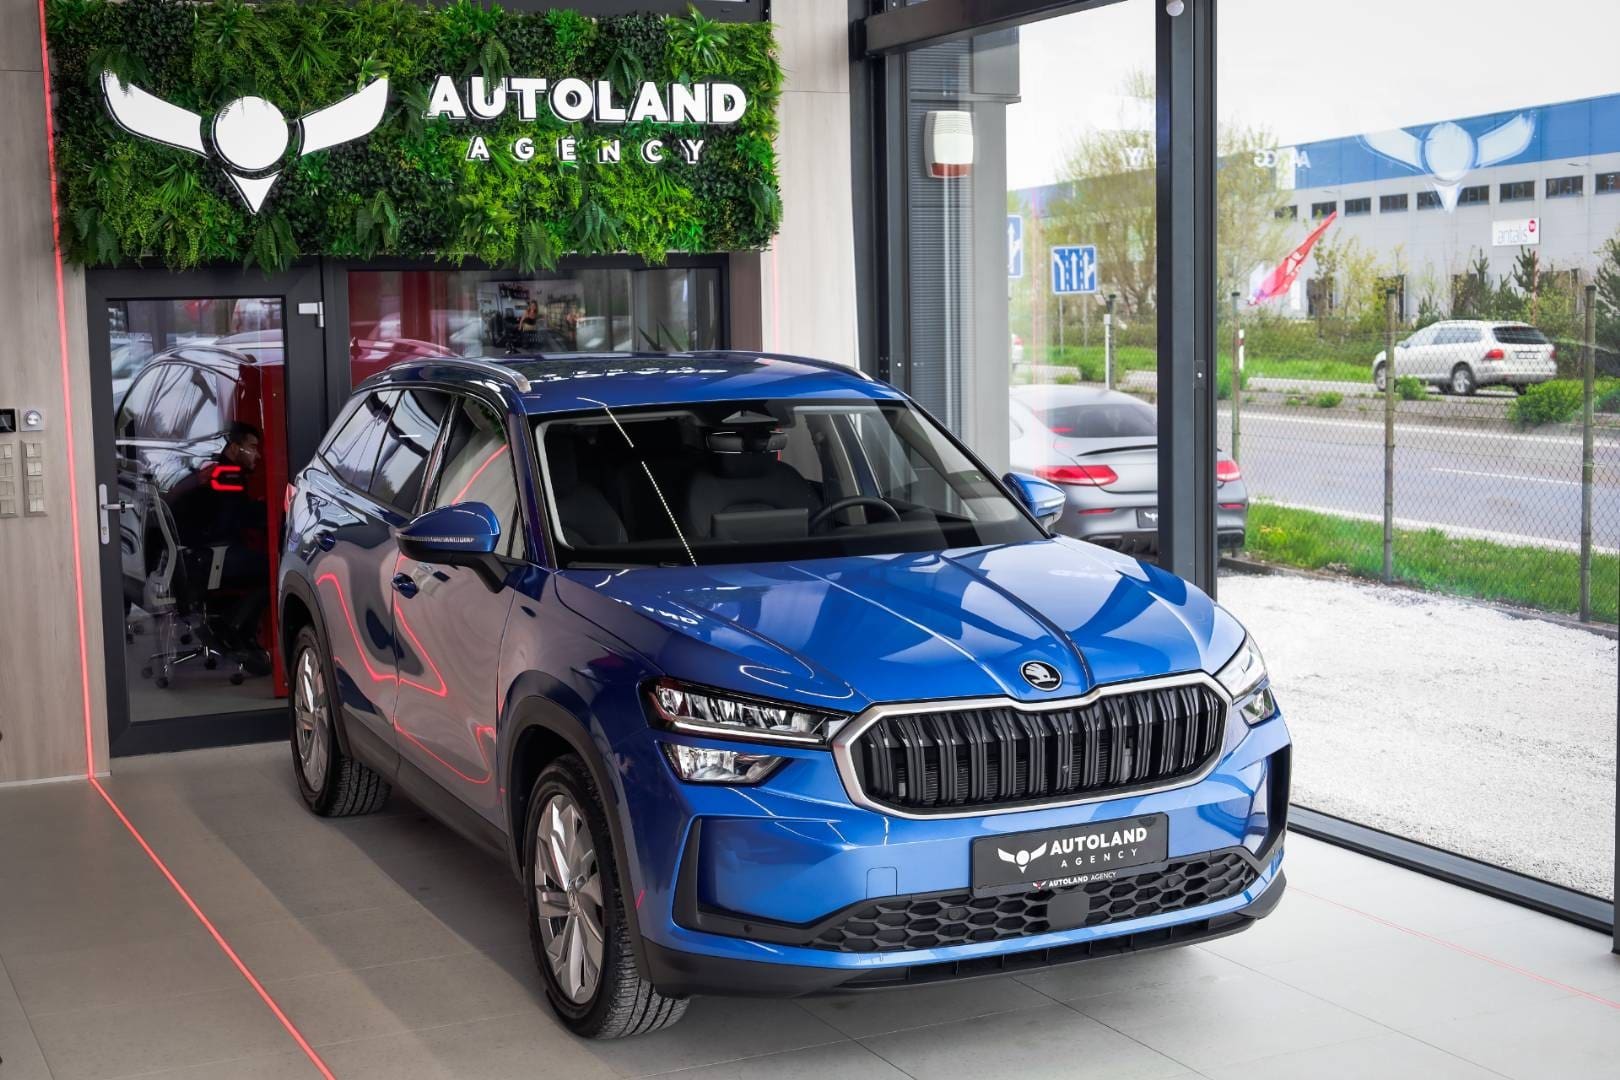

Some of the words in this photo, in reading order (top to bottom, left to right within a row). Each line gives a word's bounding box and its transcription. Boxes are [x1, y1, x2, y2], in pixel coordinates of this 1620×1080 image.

[426, 74, 747, 123] AUTOLAND
[467, 136, 705, 164] AGENCY
[1050, 827, 1148, 856] AUTOLAND
[1061, 848, 1138, 868] AGENCY
[1048, 875, 1089, 887] AUTOLAND
[1090, 871, 1117, 882] AGENCY
